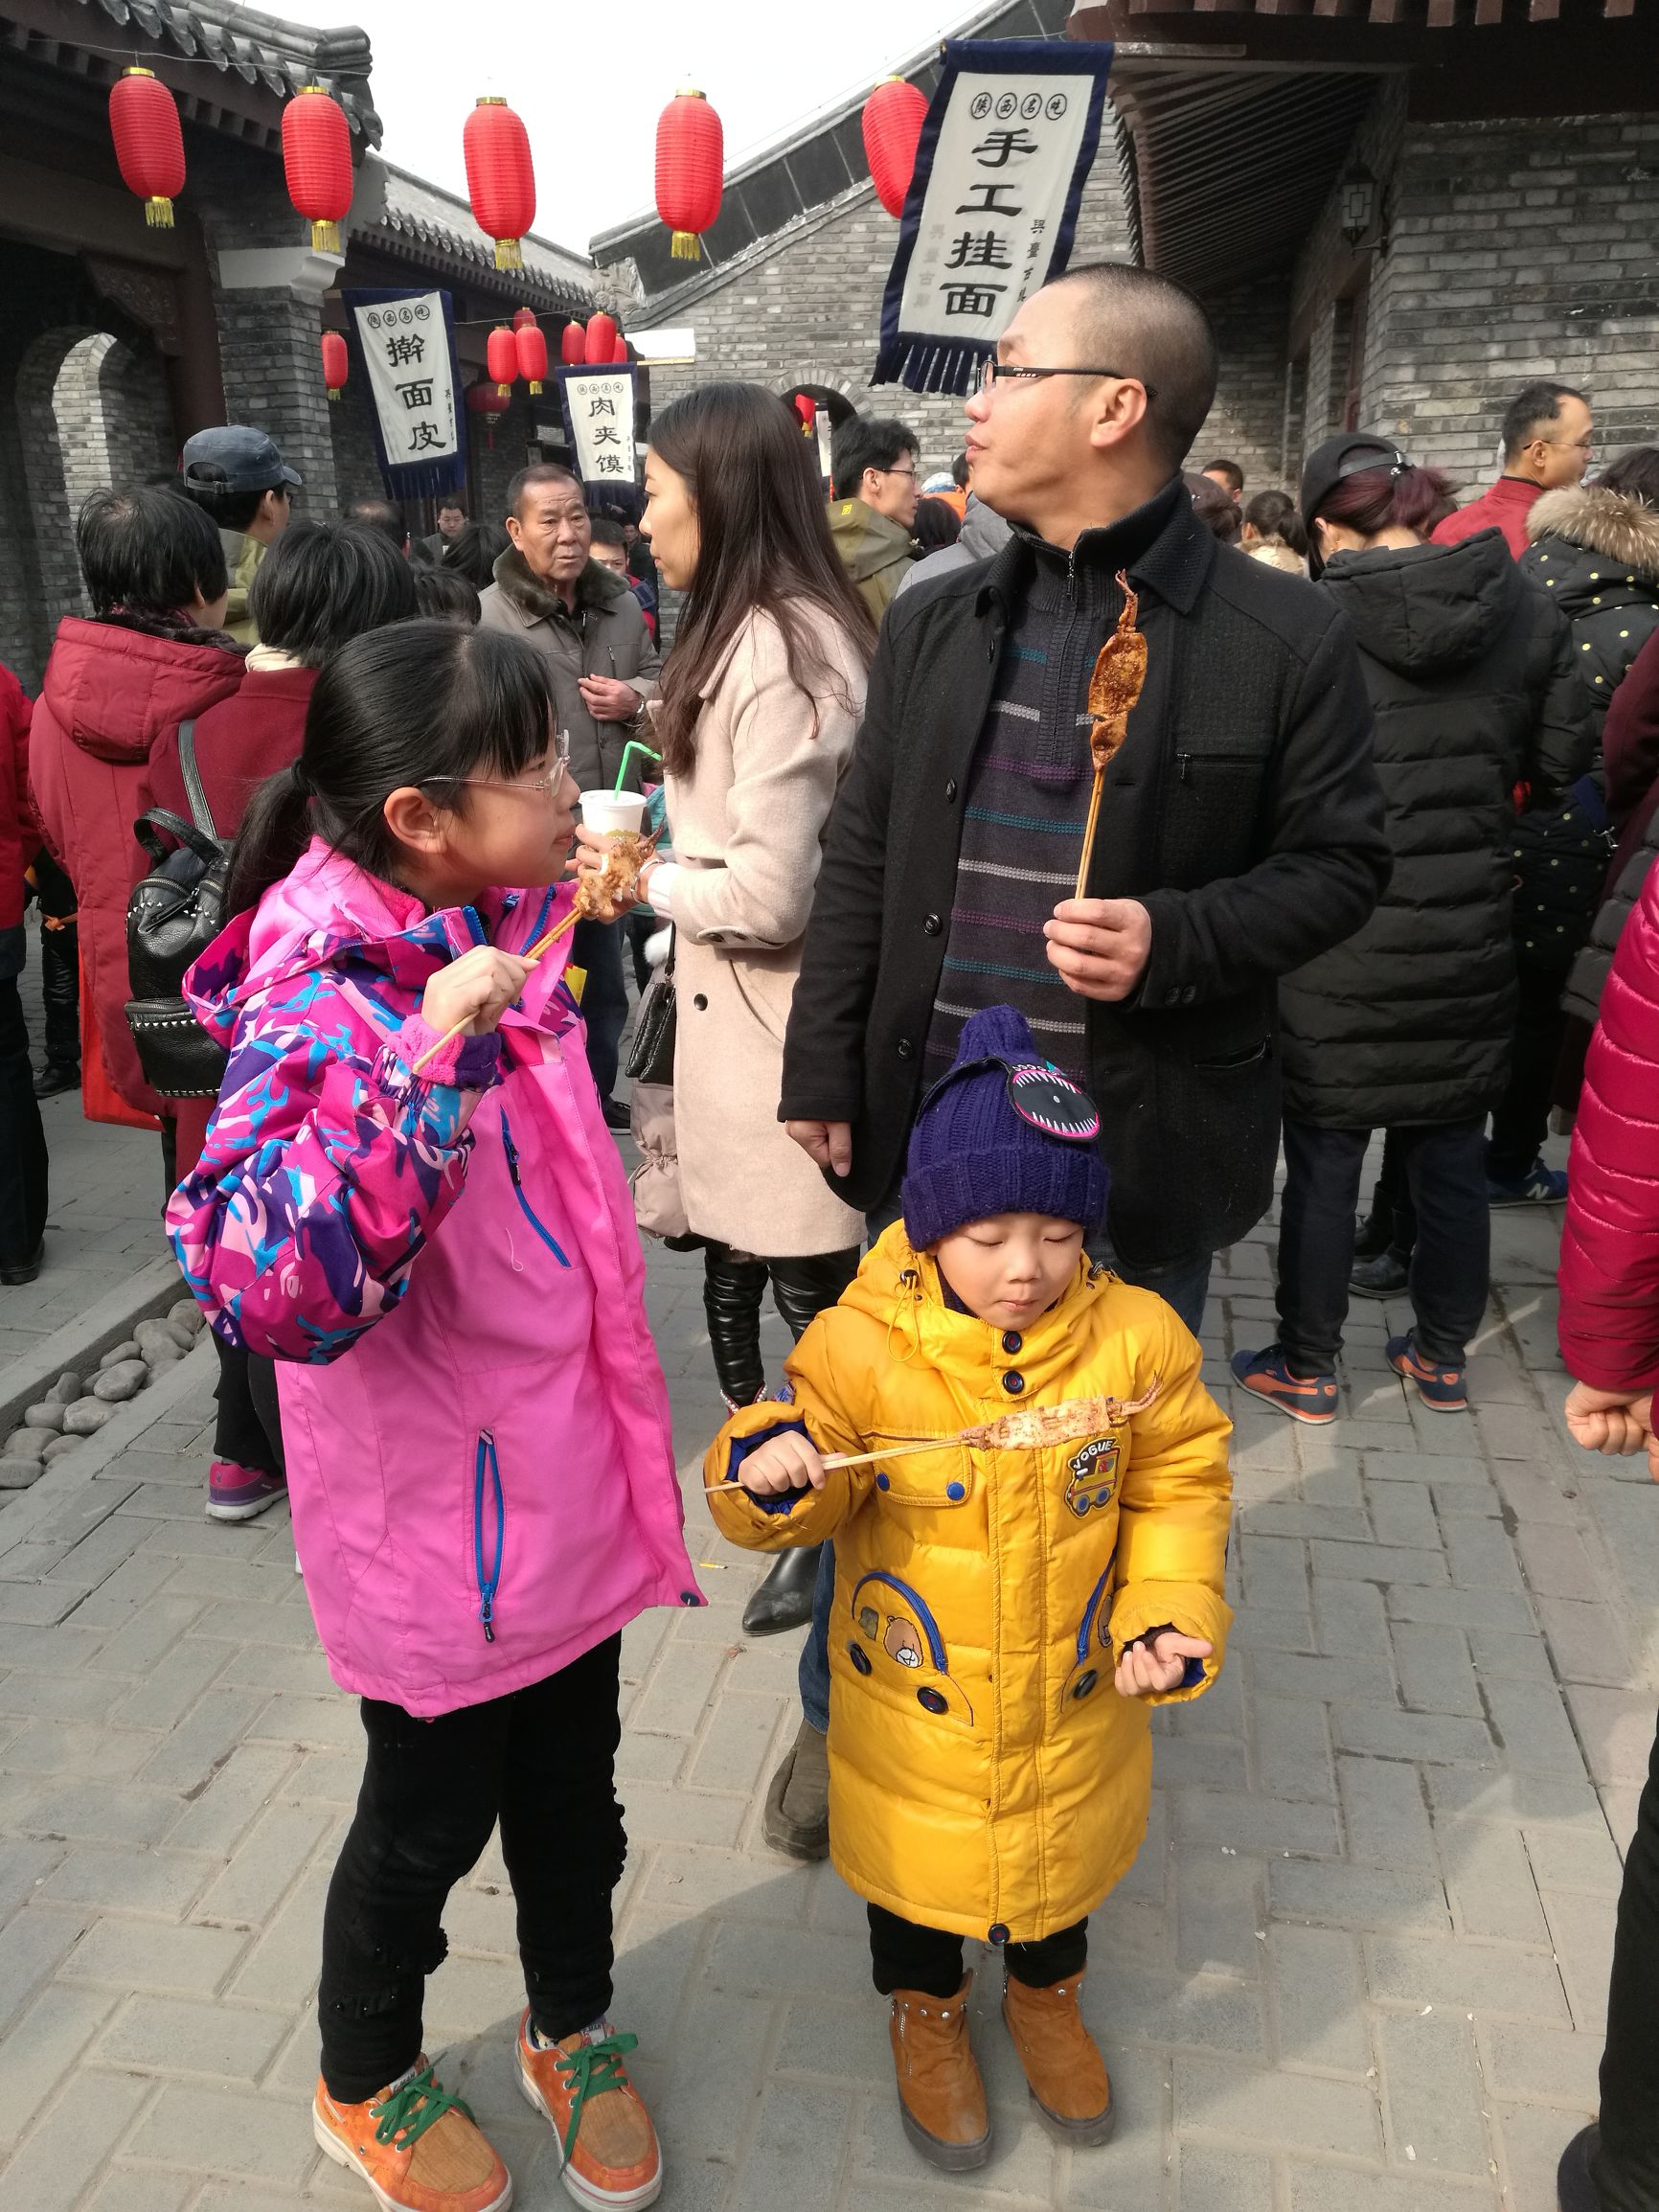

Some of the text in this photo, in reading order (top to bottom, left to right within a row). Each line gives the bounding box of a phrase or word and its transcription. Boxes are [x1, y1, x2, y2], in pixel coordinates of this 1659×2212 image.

[939, 127, 1038, 317] 手工挂面
[386, 333, 446, 450] 擀面皮
[588, 397, 625, 473] 肉夹馍
[1073, 1440, 1113, 1470] VOGUE
